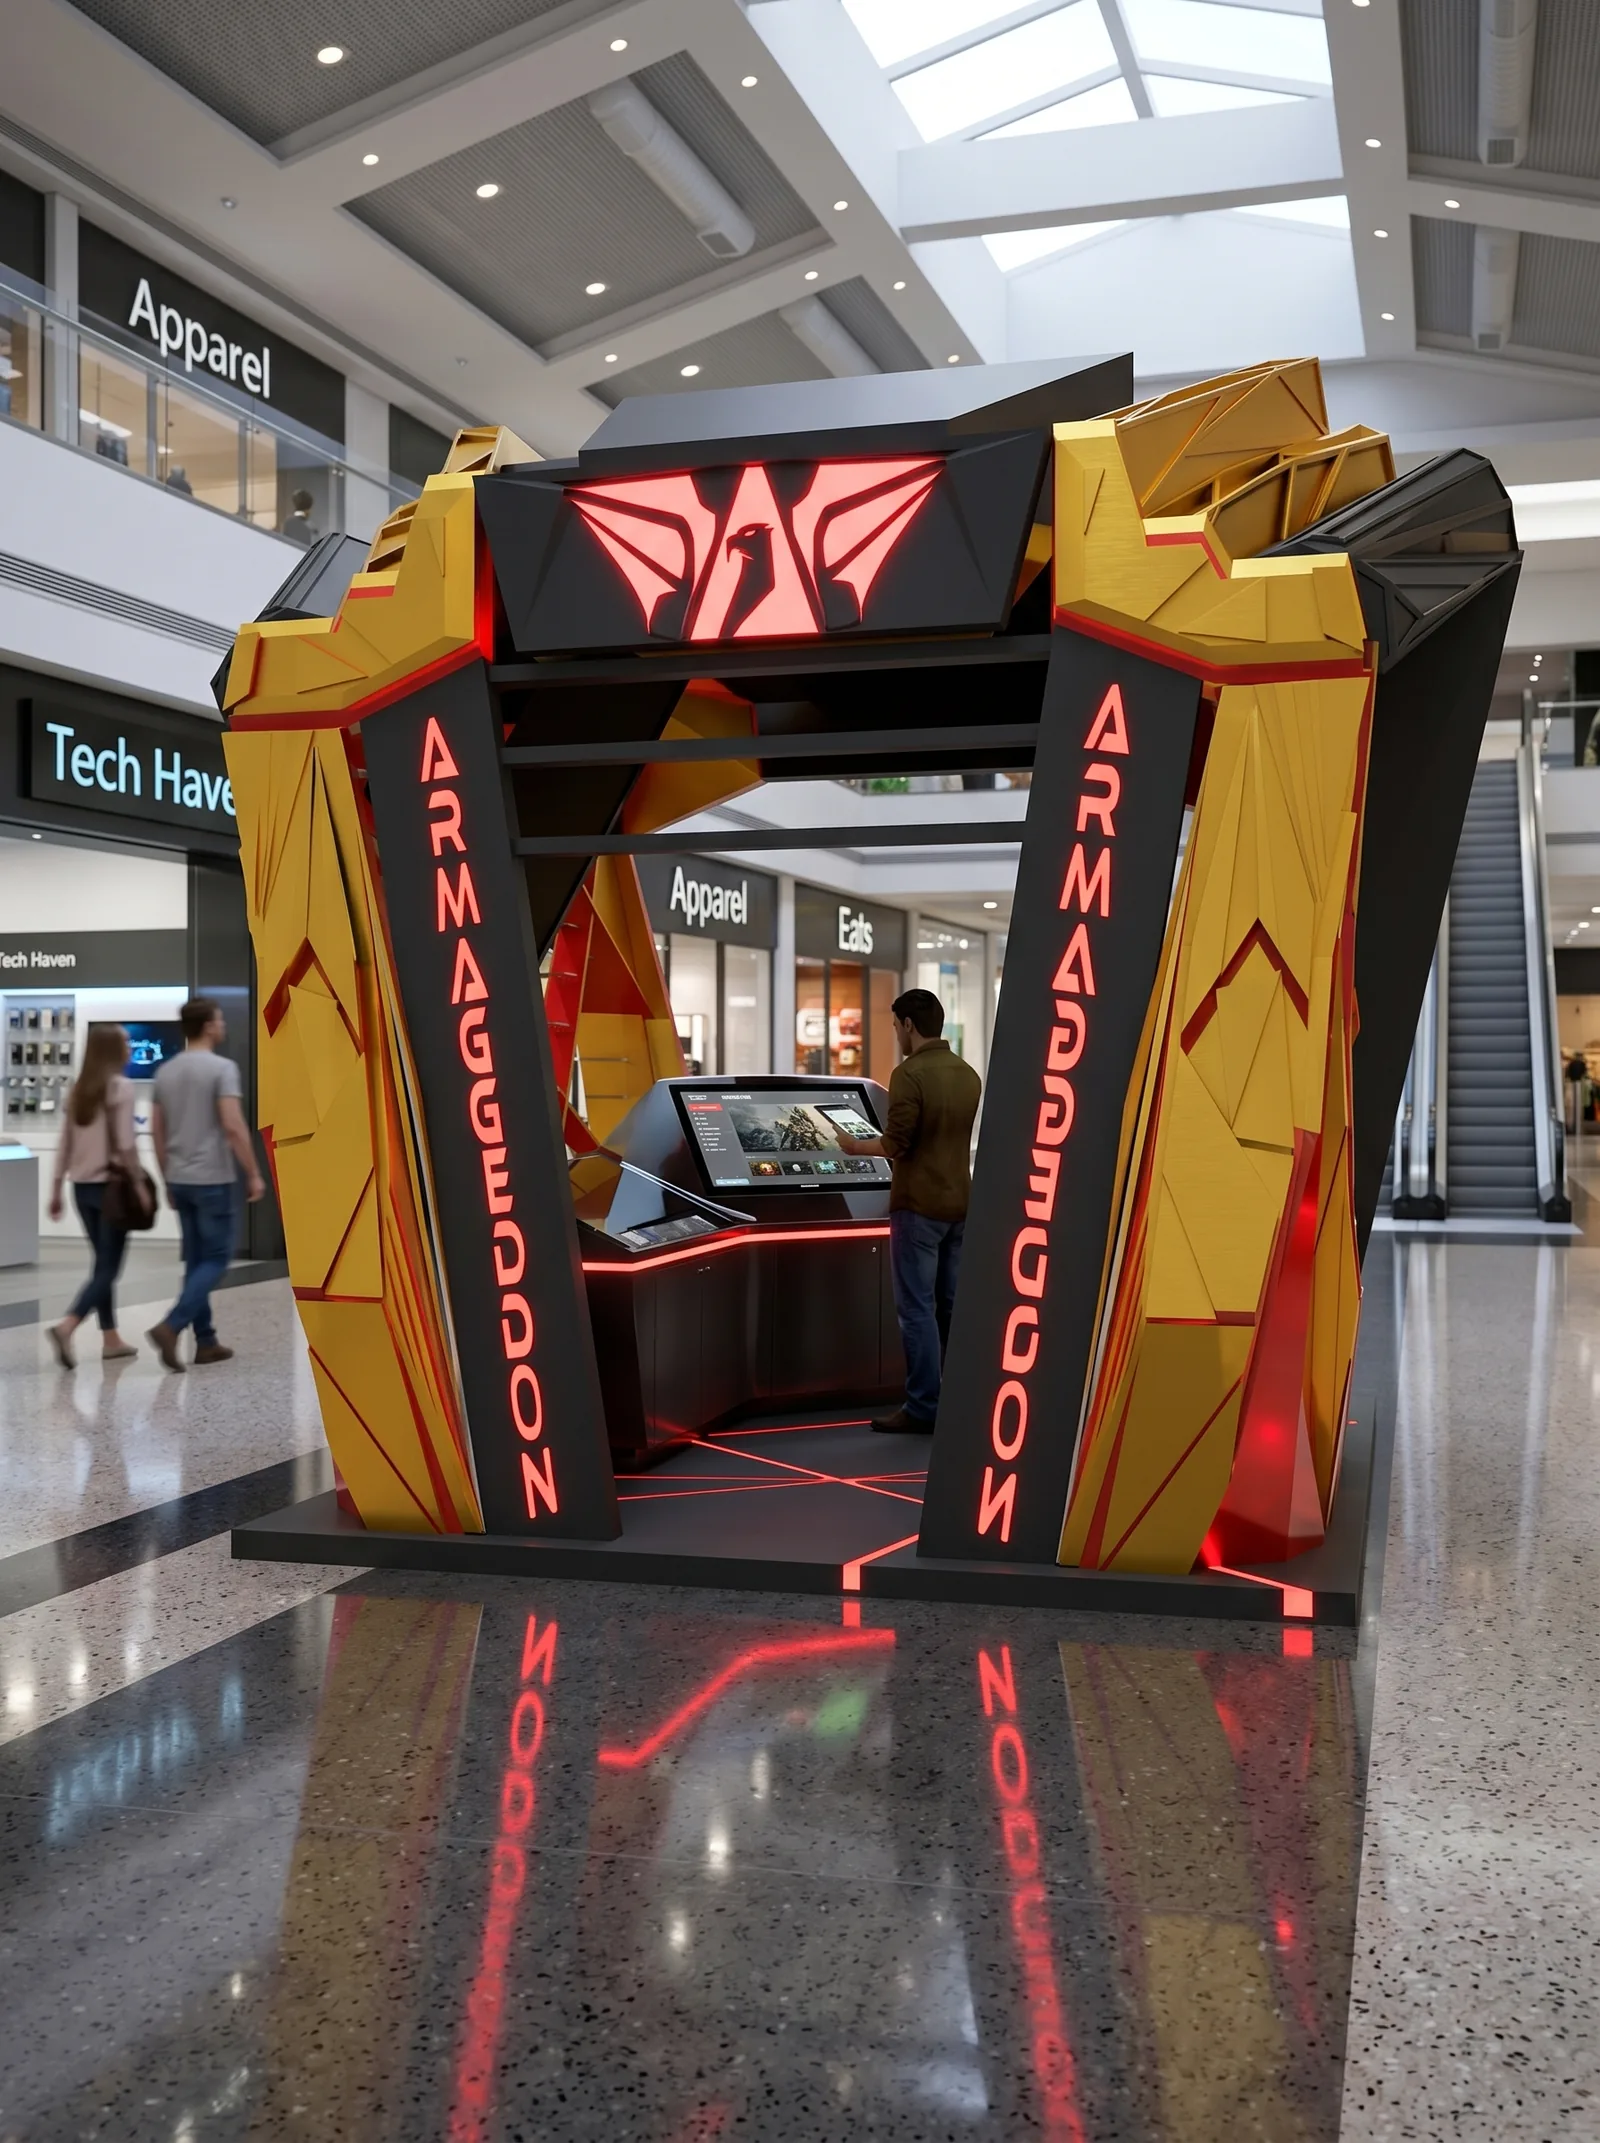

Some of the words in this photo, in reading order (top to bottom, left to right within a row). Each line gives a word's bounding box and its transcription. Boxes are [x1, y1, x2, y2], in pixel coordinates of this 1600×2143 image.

[128, 278, 270, 399] Apparel
[45, 722, 142, 797] Tech
[154, 748, 236, 817] Have
[669, 865, 748, 928] Apparel
[838, 905, 874, 955] Eats
[30, 950, 77, 968] Haven
[420, 715, 559, 1520] ARMAGGEDDON
